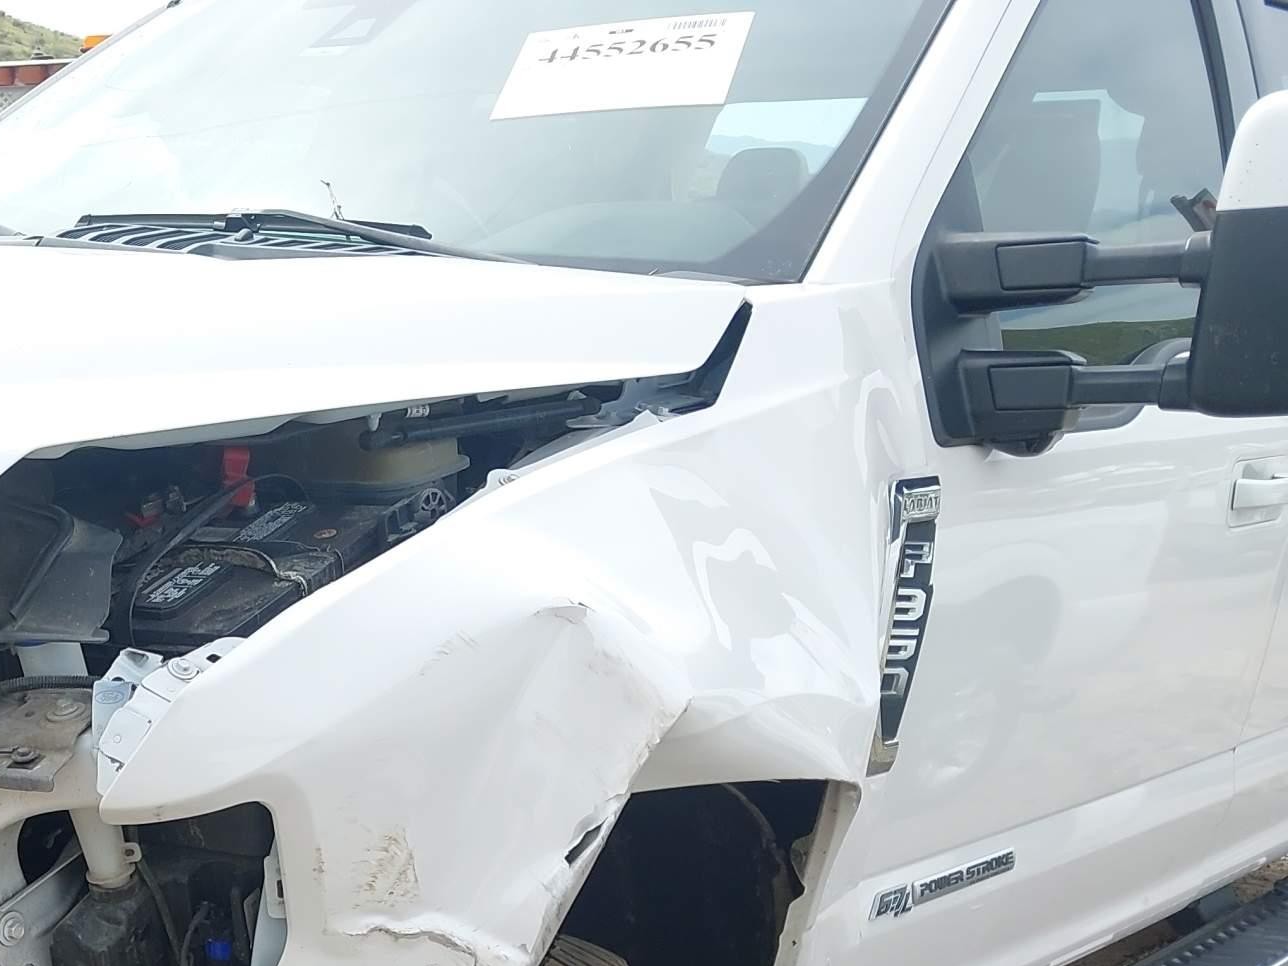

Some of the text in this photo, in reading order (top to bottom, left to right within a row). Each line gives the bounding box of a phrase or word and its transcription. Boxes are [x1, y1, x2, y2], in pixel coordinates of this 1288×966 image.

[538, 34, 718, 63] 44552655
[919, 869, 964, 897] POWER
[965, 851, 1014, 881] STROKE
